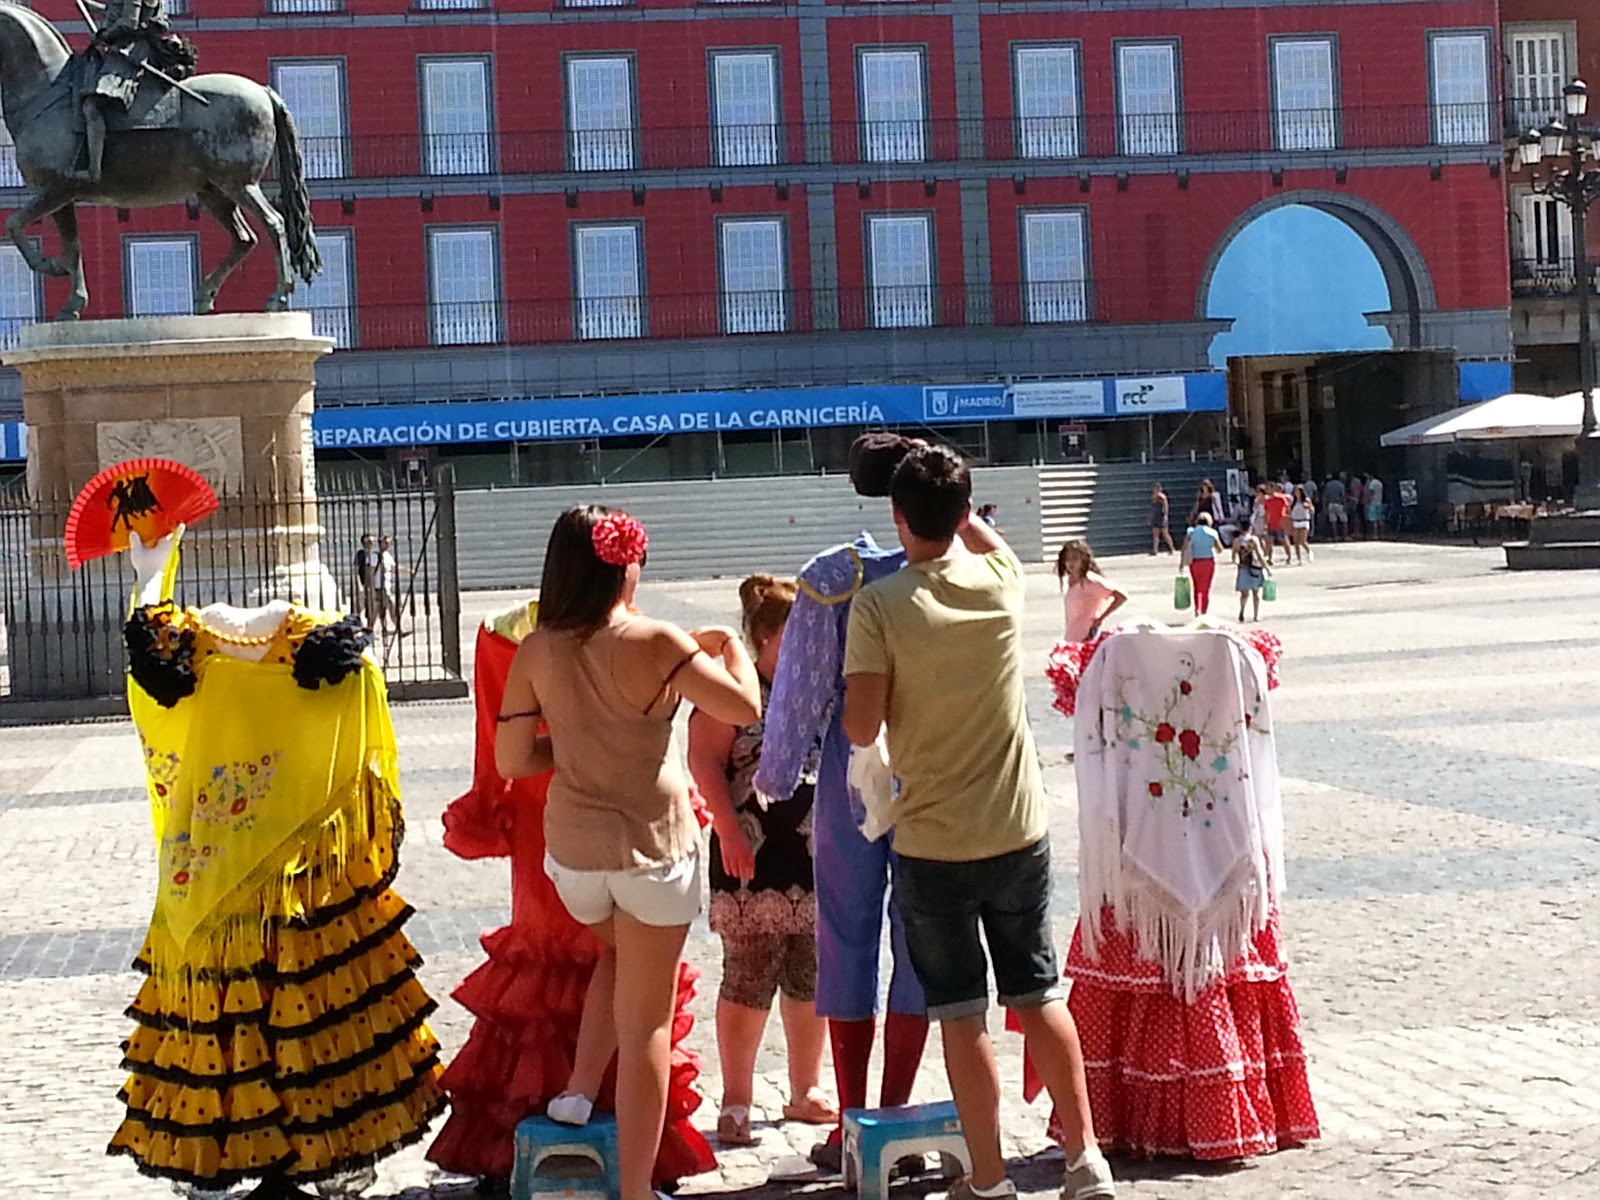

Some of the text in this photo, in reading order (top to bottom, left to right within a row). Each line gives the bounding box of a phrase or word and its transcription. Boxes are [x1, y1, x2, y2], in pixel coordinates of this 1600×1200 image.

[312, 401, 884, 445] REPARACIÓN DE CUBIERTA. CASA DE LA CARNICERÍA
